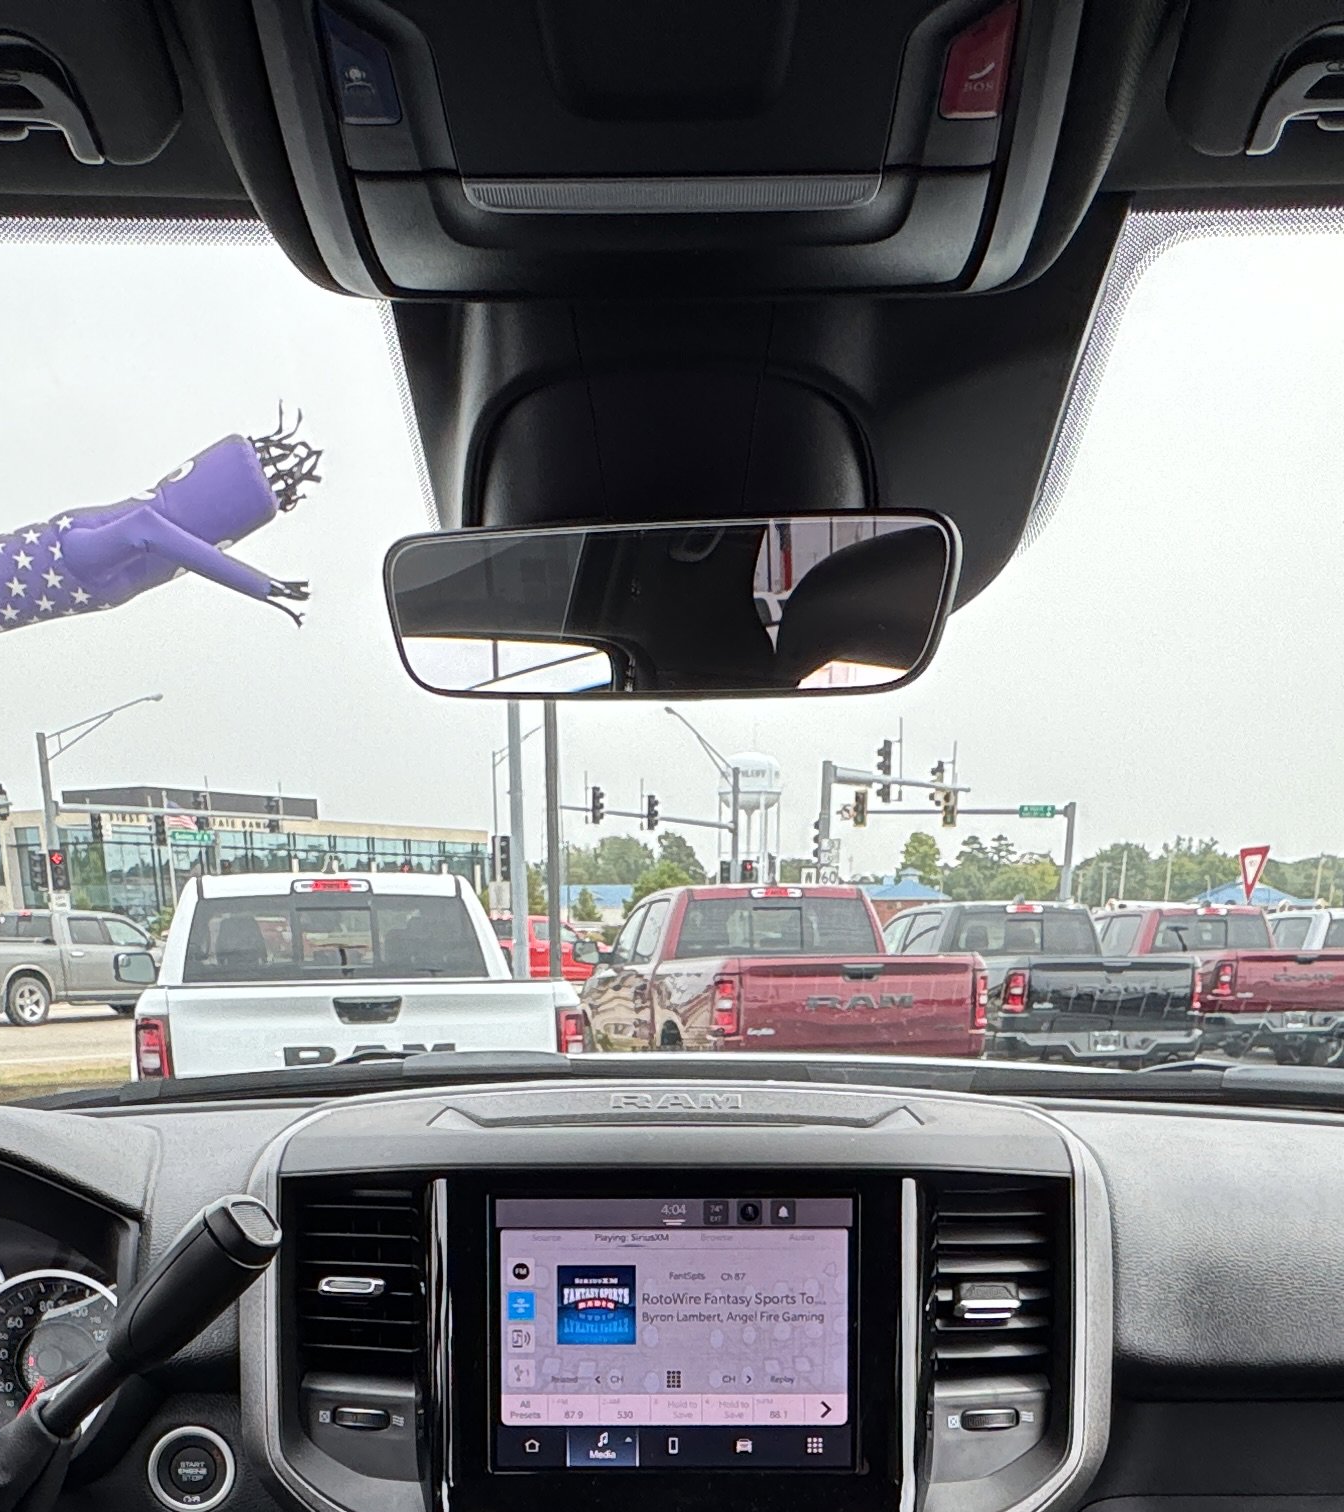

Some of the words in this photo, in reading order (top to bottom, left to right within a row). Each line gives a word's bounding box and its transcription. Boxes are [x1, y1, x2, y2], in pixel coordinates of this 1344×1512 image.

[821, 871, 837, 884] 60
[806, 993, 913, 1010] RAM
[610, 1092, 742, 1110] RAM
[661, 1204, 687, 1215] 4:04
[514, 1267, 527, 1275] FM
[642, 1293, 701, 1305] RotoWire
[704, 1293, 752, 1308] Fantasy
[755, 1293, 797, 1308] Sports
[39, 1301, 54, 1312] 80
[642, 1311, 674, 1325] Byron
[726, 1311, 756, 1325] Angel
[760, 1311, 779, 1323] Fire
[782, 1311, 825, 1324] Gaming
[7, 1319, 23, 1329] 60
[610, 1375, 624, 1384] CH
[722, 1375, 736, 1383] CH
[617, 1411, 634, 1419] 530
[589, 1450, 616, 1459] Media
